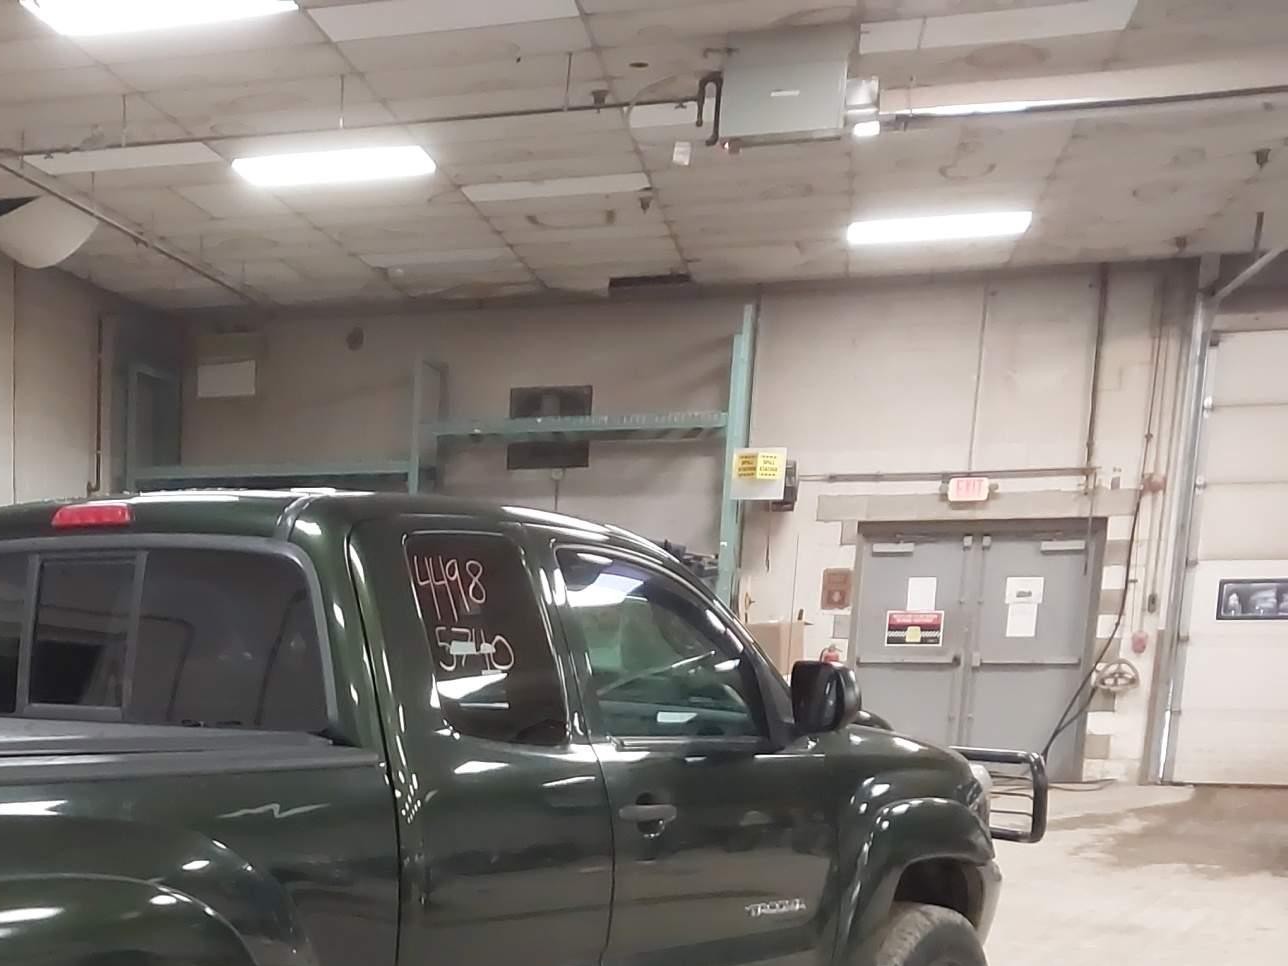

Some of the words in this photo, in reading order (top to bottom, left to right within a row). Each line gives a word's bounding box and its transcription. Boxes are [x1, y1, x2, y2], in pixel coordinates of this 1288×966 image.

[956, 479, 984, 497] EXIT
[414, 555, 486, 622] 4498
[435, 626, 514, 671] 5740
